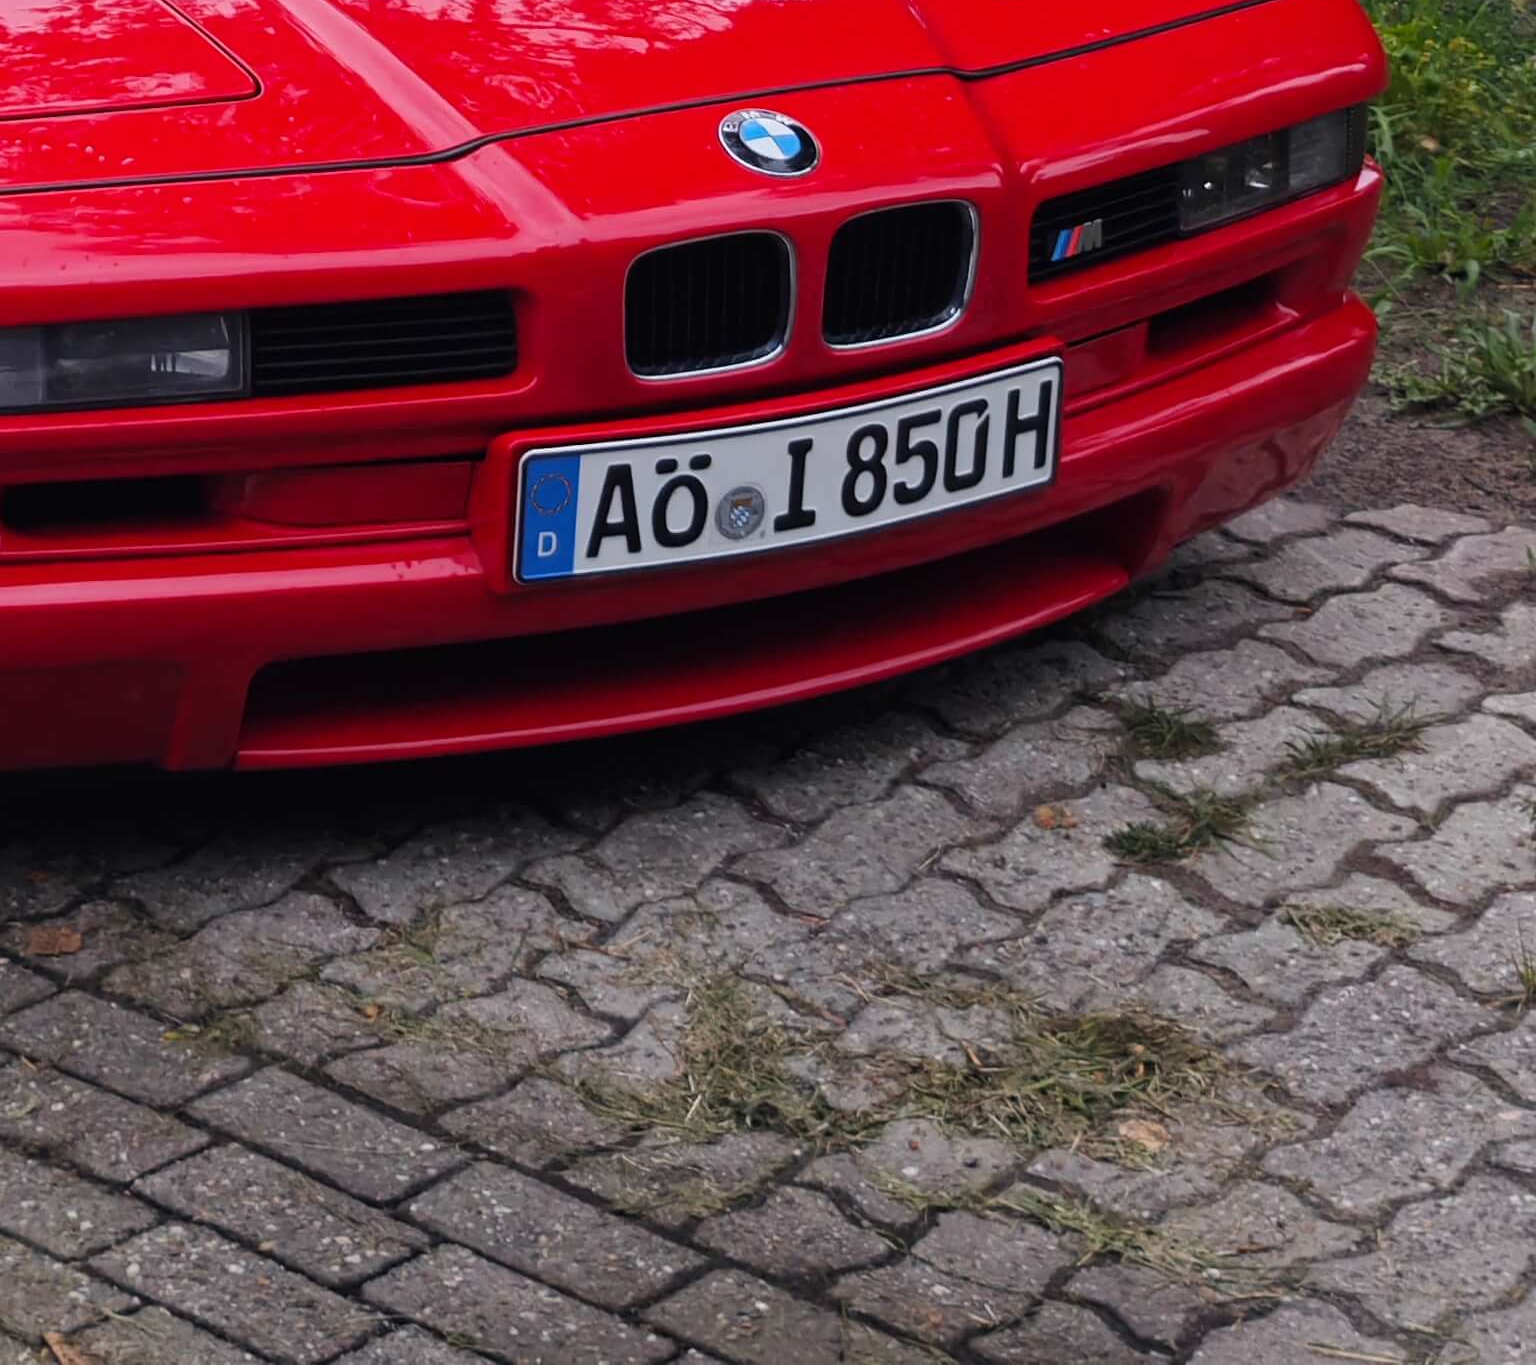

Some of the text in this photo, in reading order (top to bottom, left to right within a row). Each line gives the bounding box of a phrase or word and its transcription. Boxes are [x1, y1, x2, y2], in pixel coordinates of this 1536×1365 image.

[585, 452, 712, 559] AÖ
[773, 437, 816, 533] I
[536, 531, 557, 557] D
